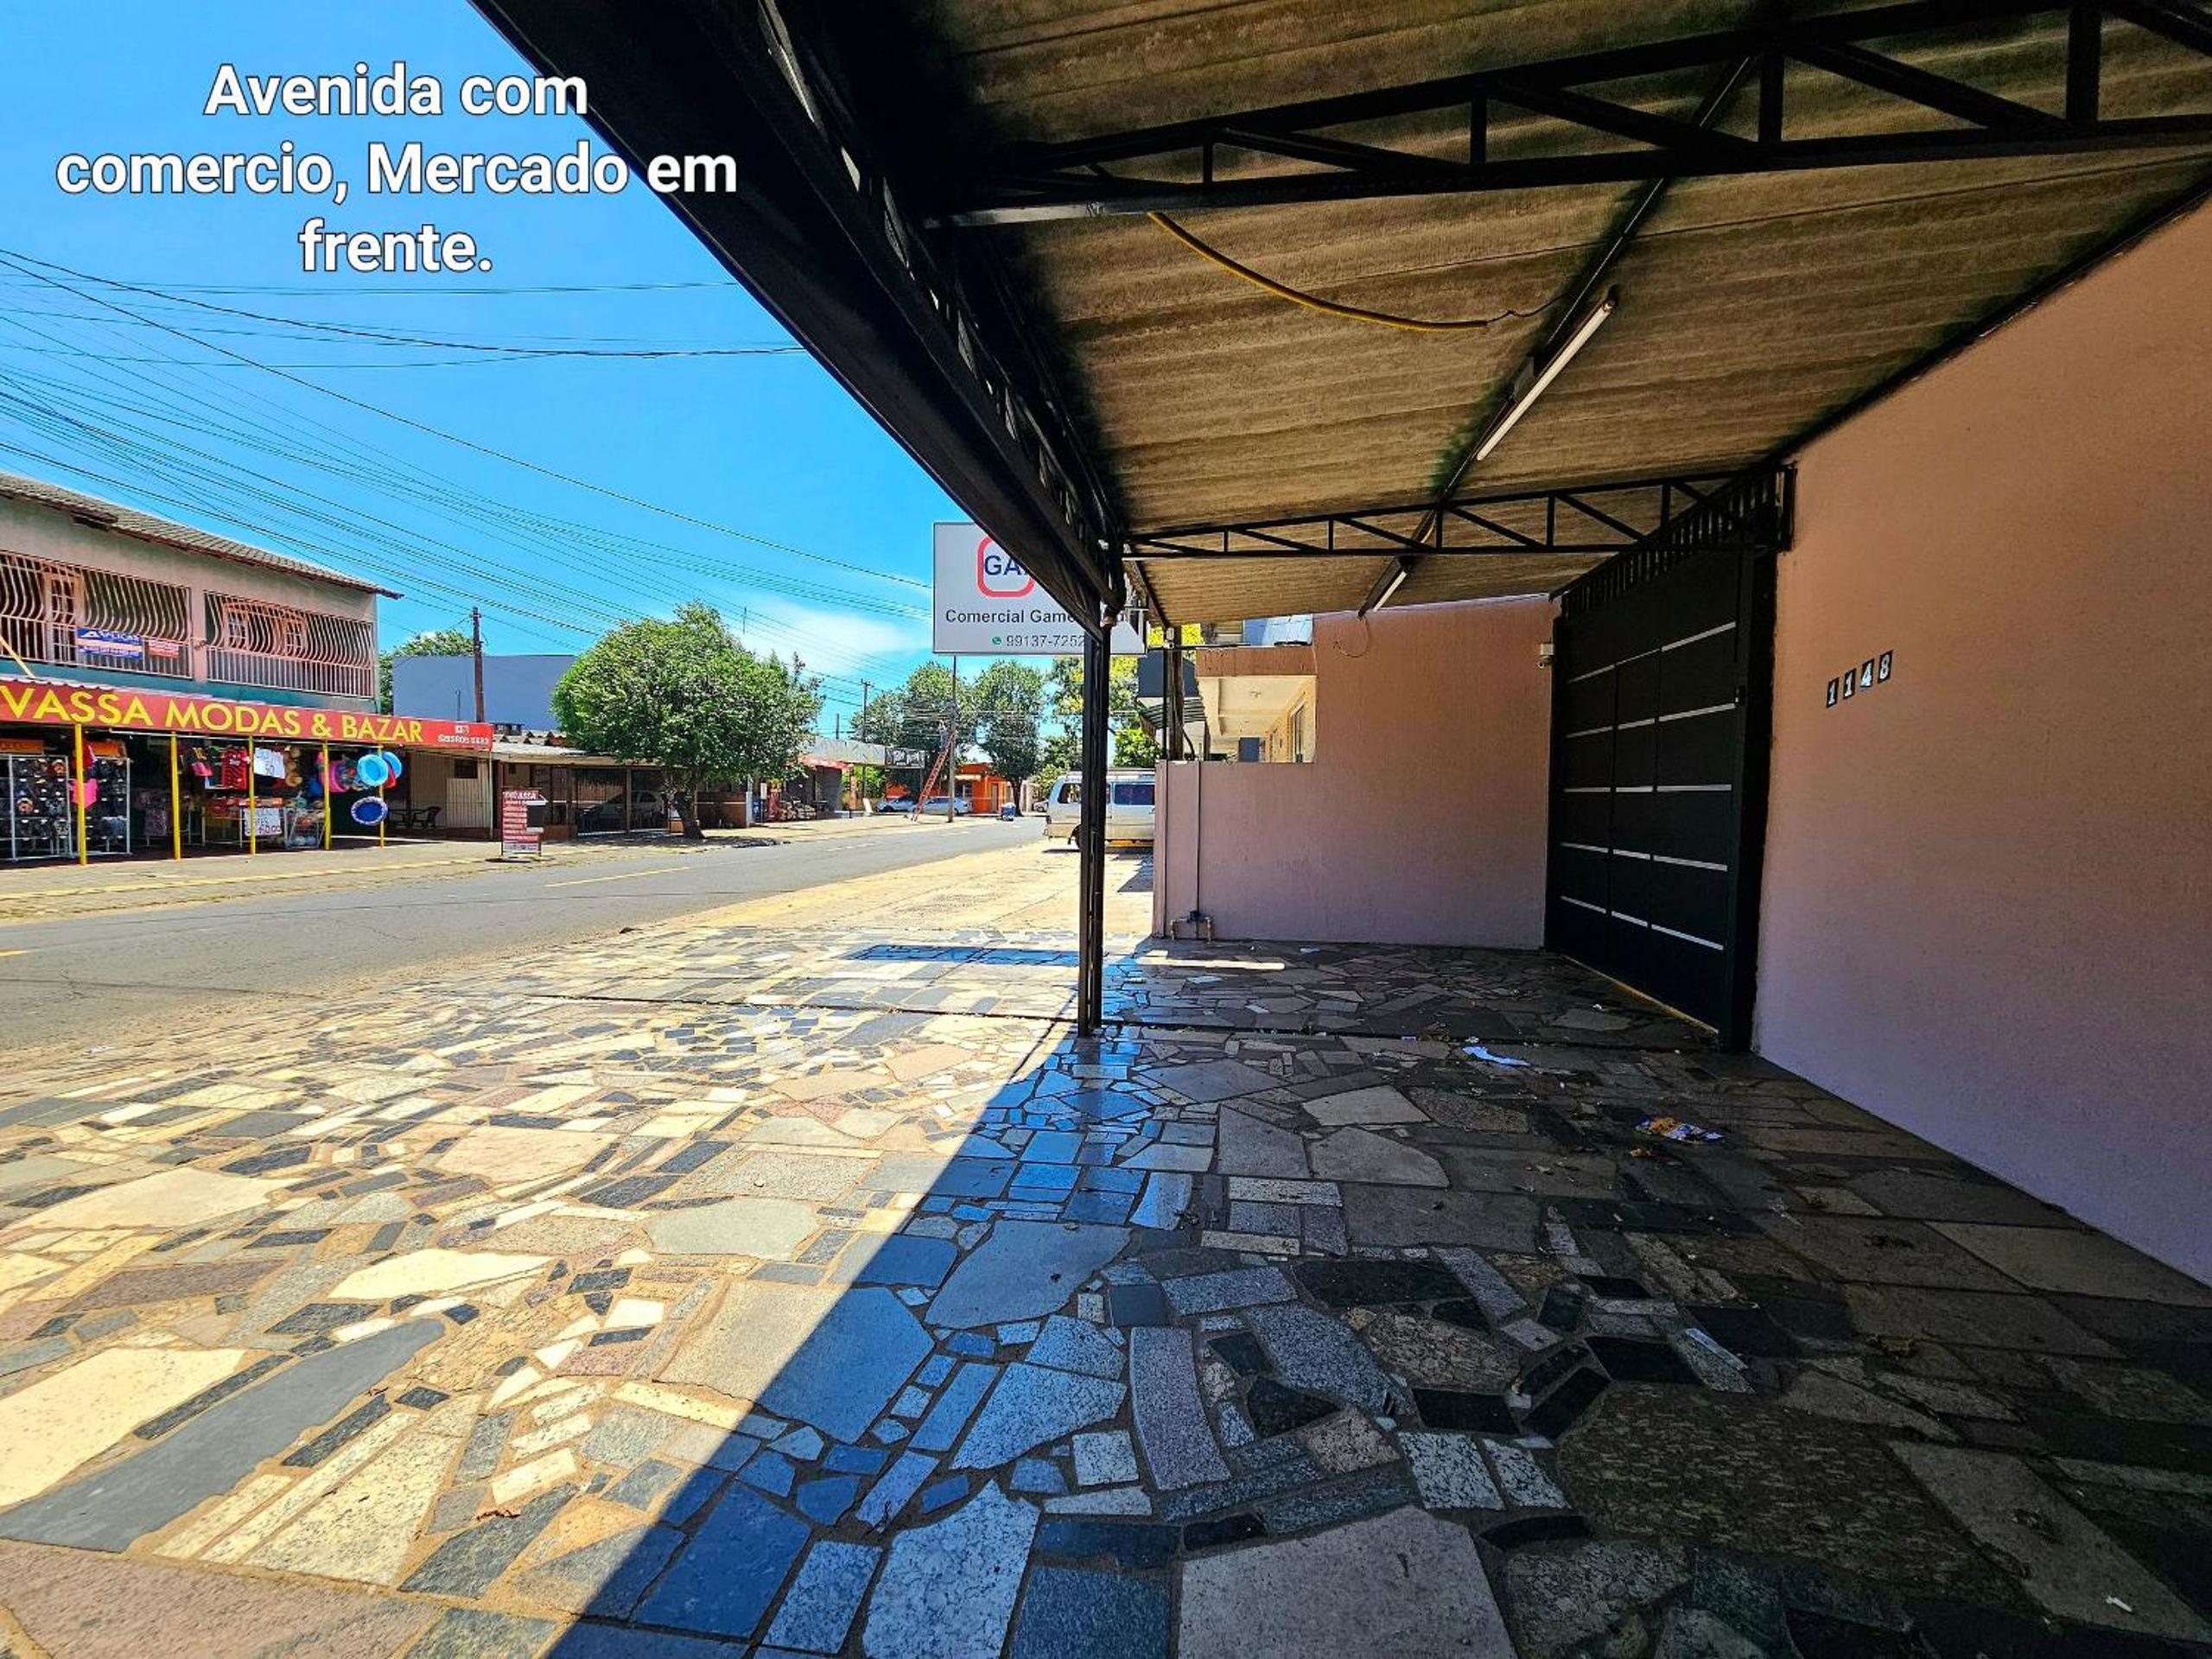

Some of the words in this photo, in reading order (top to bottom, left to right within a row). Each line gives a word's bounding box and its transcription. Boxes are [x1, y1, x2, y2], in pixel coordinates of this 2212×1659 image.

[983, 555, 1029, 576] GA
[946, 609, 1025, 623] Comercial
[1827, 653, 1891, 706] 1148
[165, 698, 302, 735] MODAS
[311, 713, 331, 738] &
[341, 714, 423, 742] BAZAR
